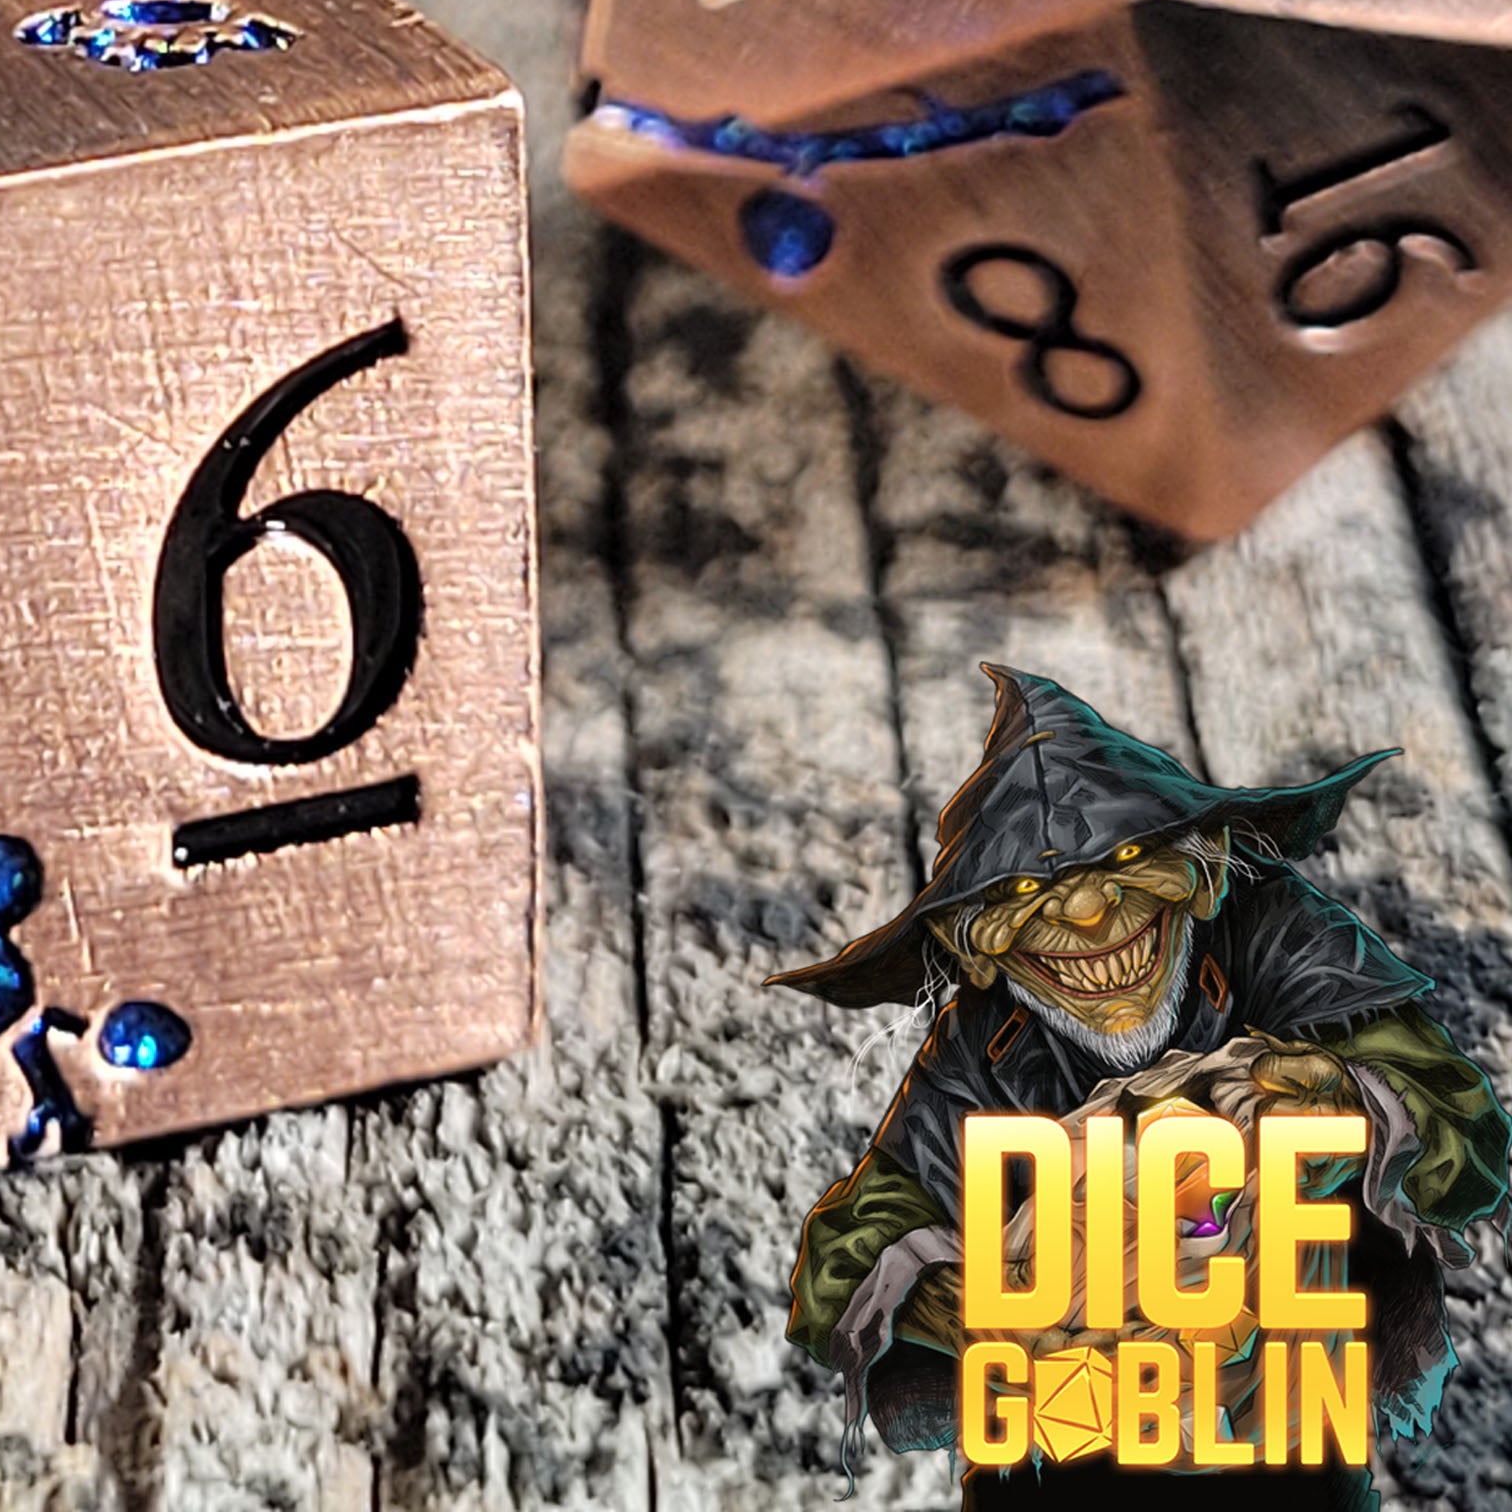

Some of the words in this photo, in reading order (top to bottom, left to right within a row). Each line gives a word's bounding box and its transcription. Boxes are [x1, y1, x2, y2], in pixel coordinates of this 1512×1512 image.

[938, 241, 1143, 420] 8
[1250, 98, 1480, 333] 16
[152, 316, 426, 768] 6
